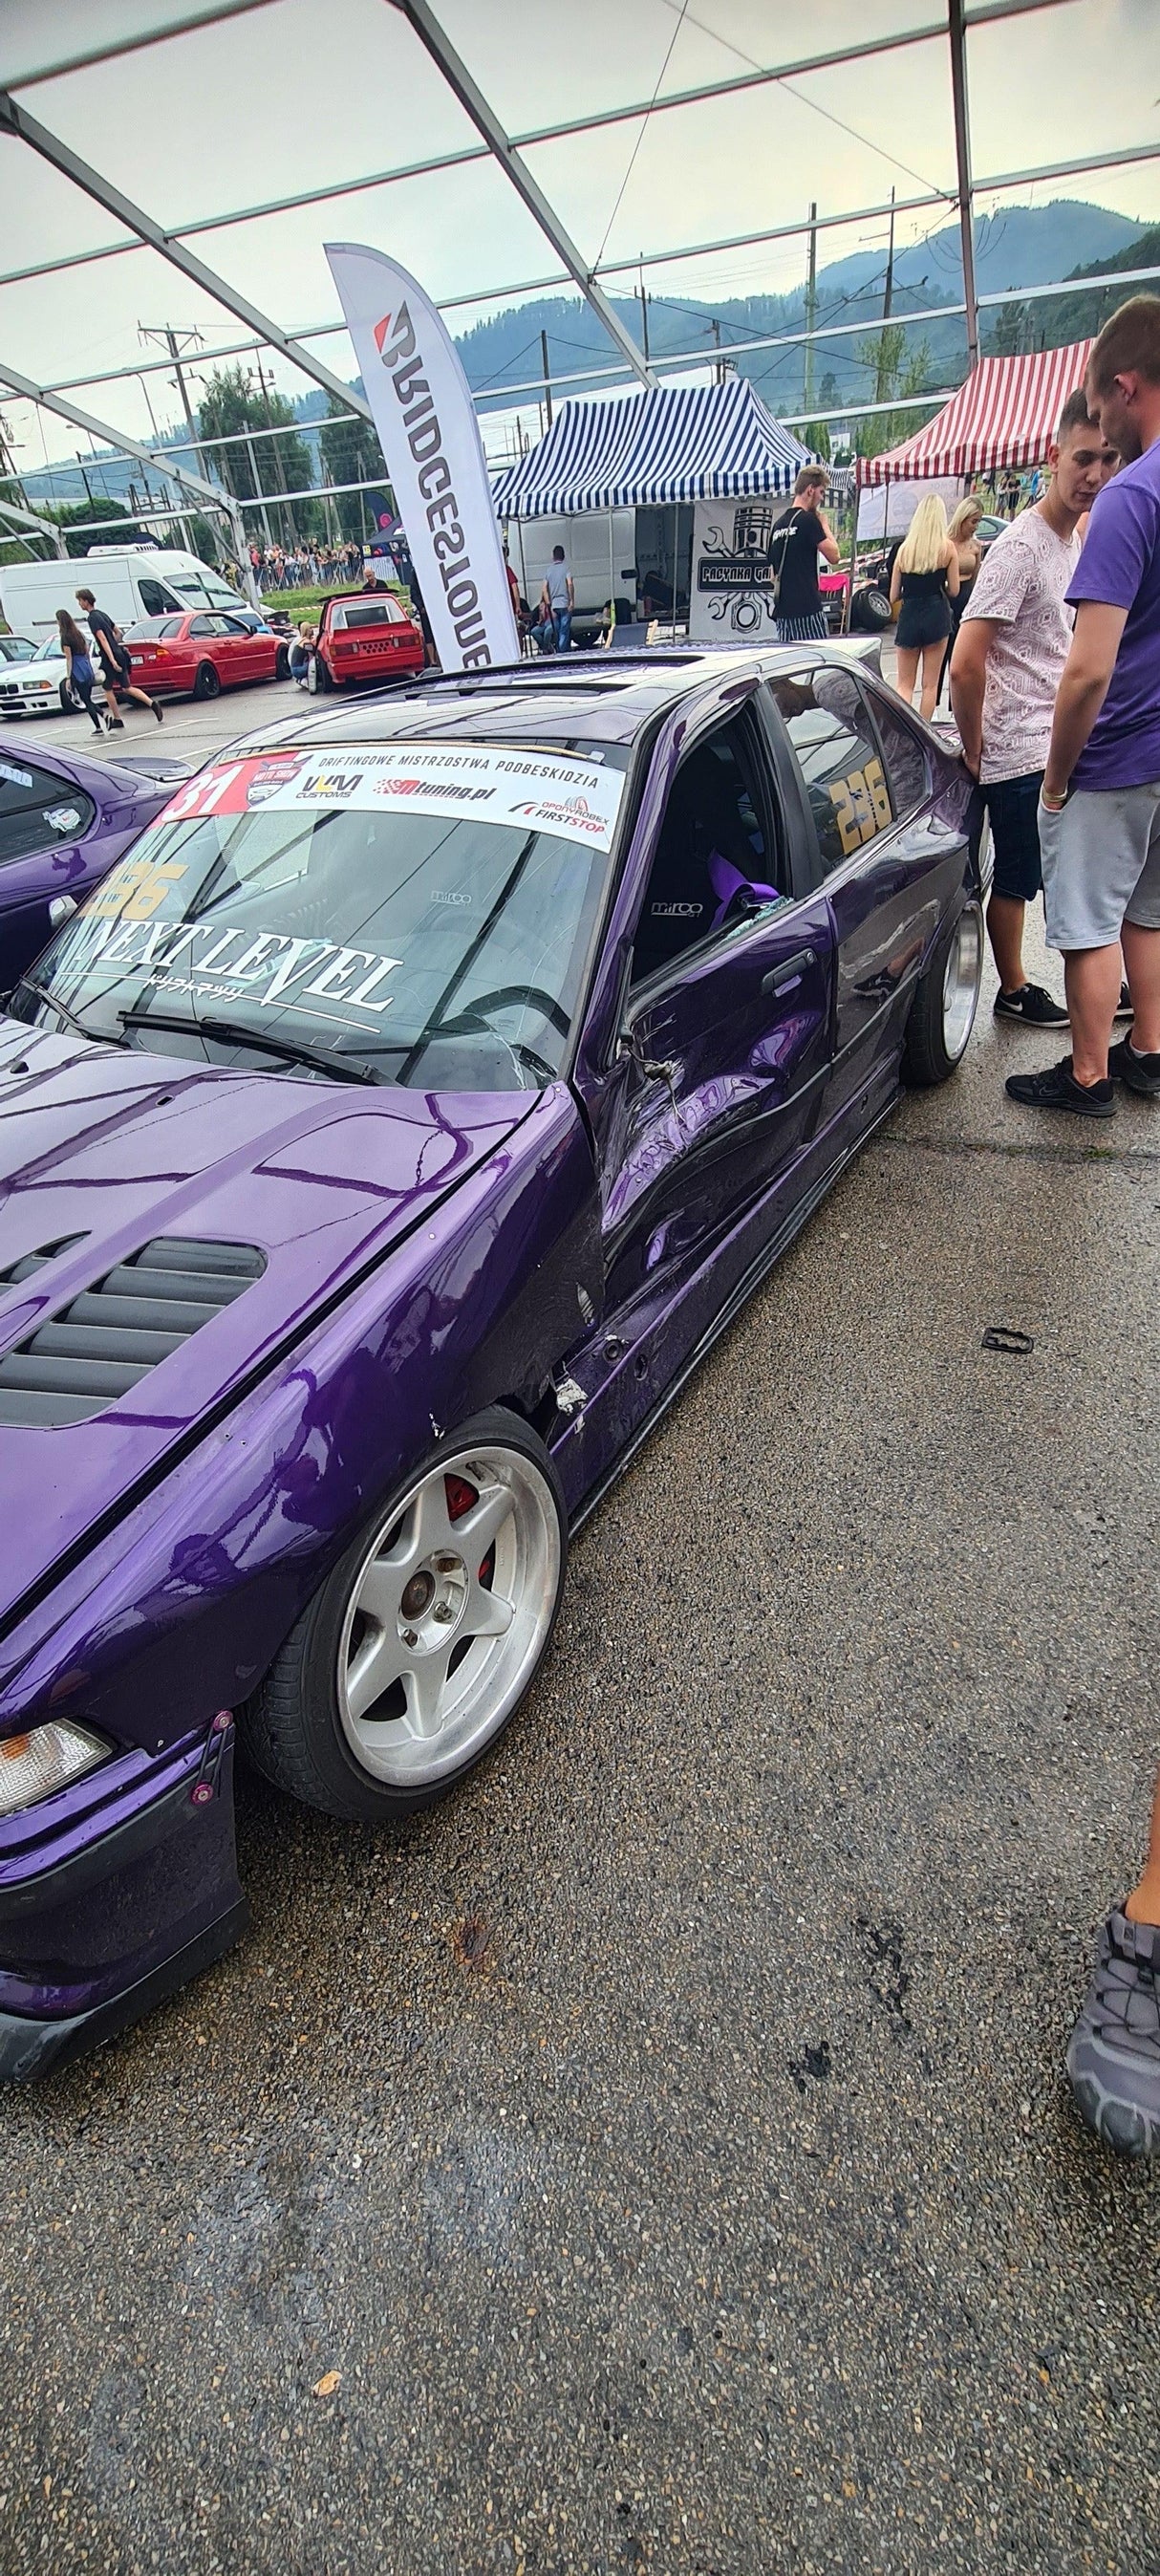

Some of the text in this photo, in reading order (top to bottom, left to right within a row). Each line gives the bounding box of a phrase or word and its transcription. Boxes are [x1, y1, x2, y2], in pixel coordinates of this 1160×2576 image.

[754, 567, 772, 583] GA
[161, 764, 245, 822] 31
[318, 754, 600, 789] DRIFTINGOWE MISTRZOSTWA PODBESKIDZIA
[75, 920, 404, 1013] NEXT LEVEL
